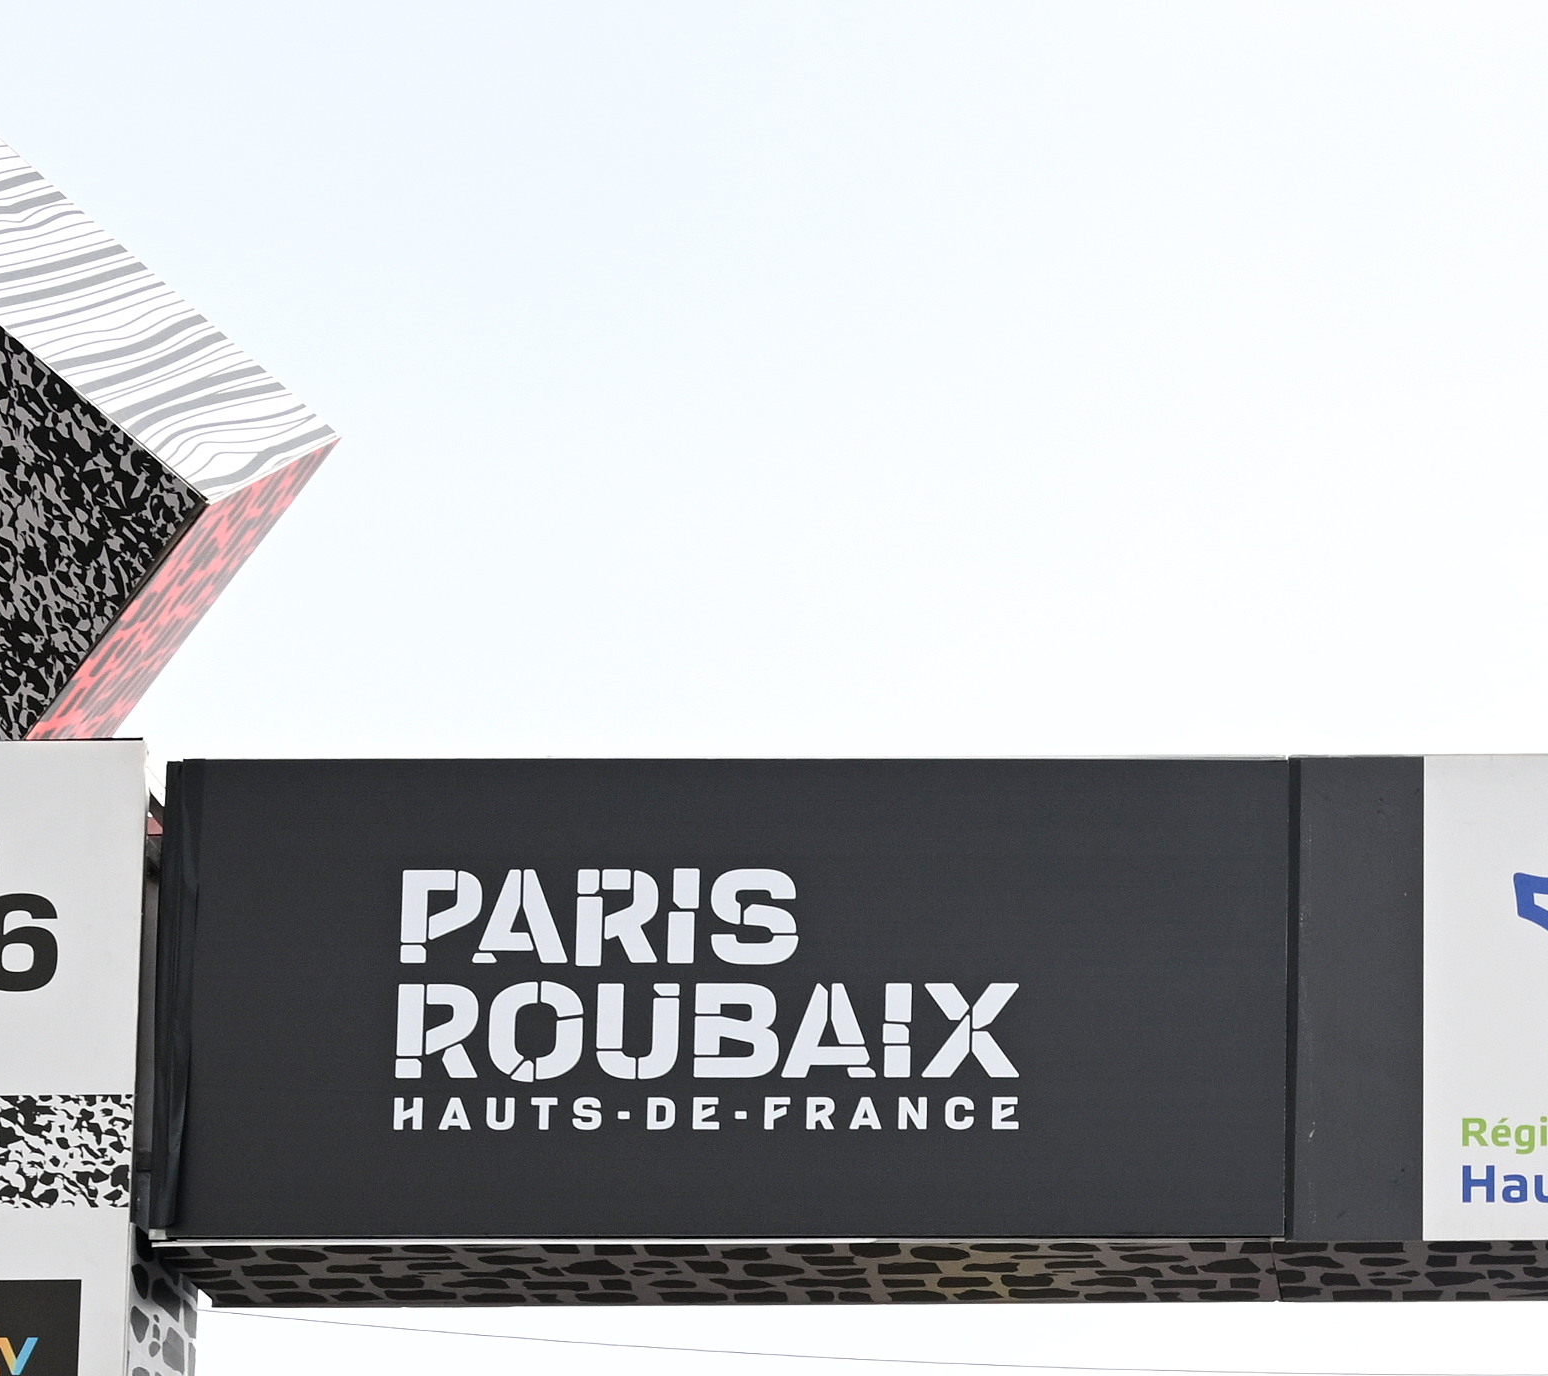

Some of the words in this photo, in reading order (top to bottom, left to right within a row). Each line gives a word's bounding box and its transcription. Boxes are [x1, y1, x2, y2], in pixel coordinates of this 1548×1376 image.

[400, 868, 799, 967] PARIS
[394, 980, 1021, 1083] ROUBAIX
[393, 1096, 1020, 1131] HAUTS-DE-FRANCE
